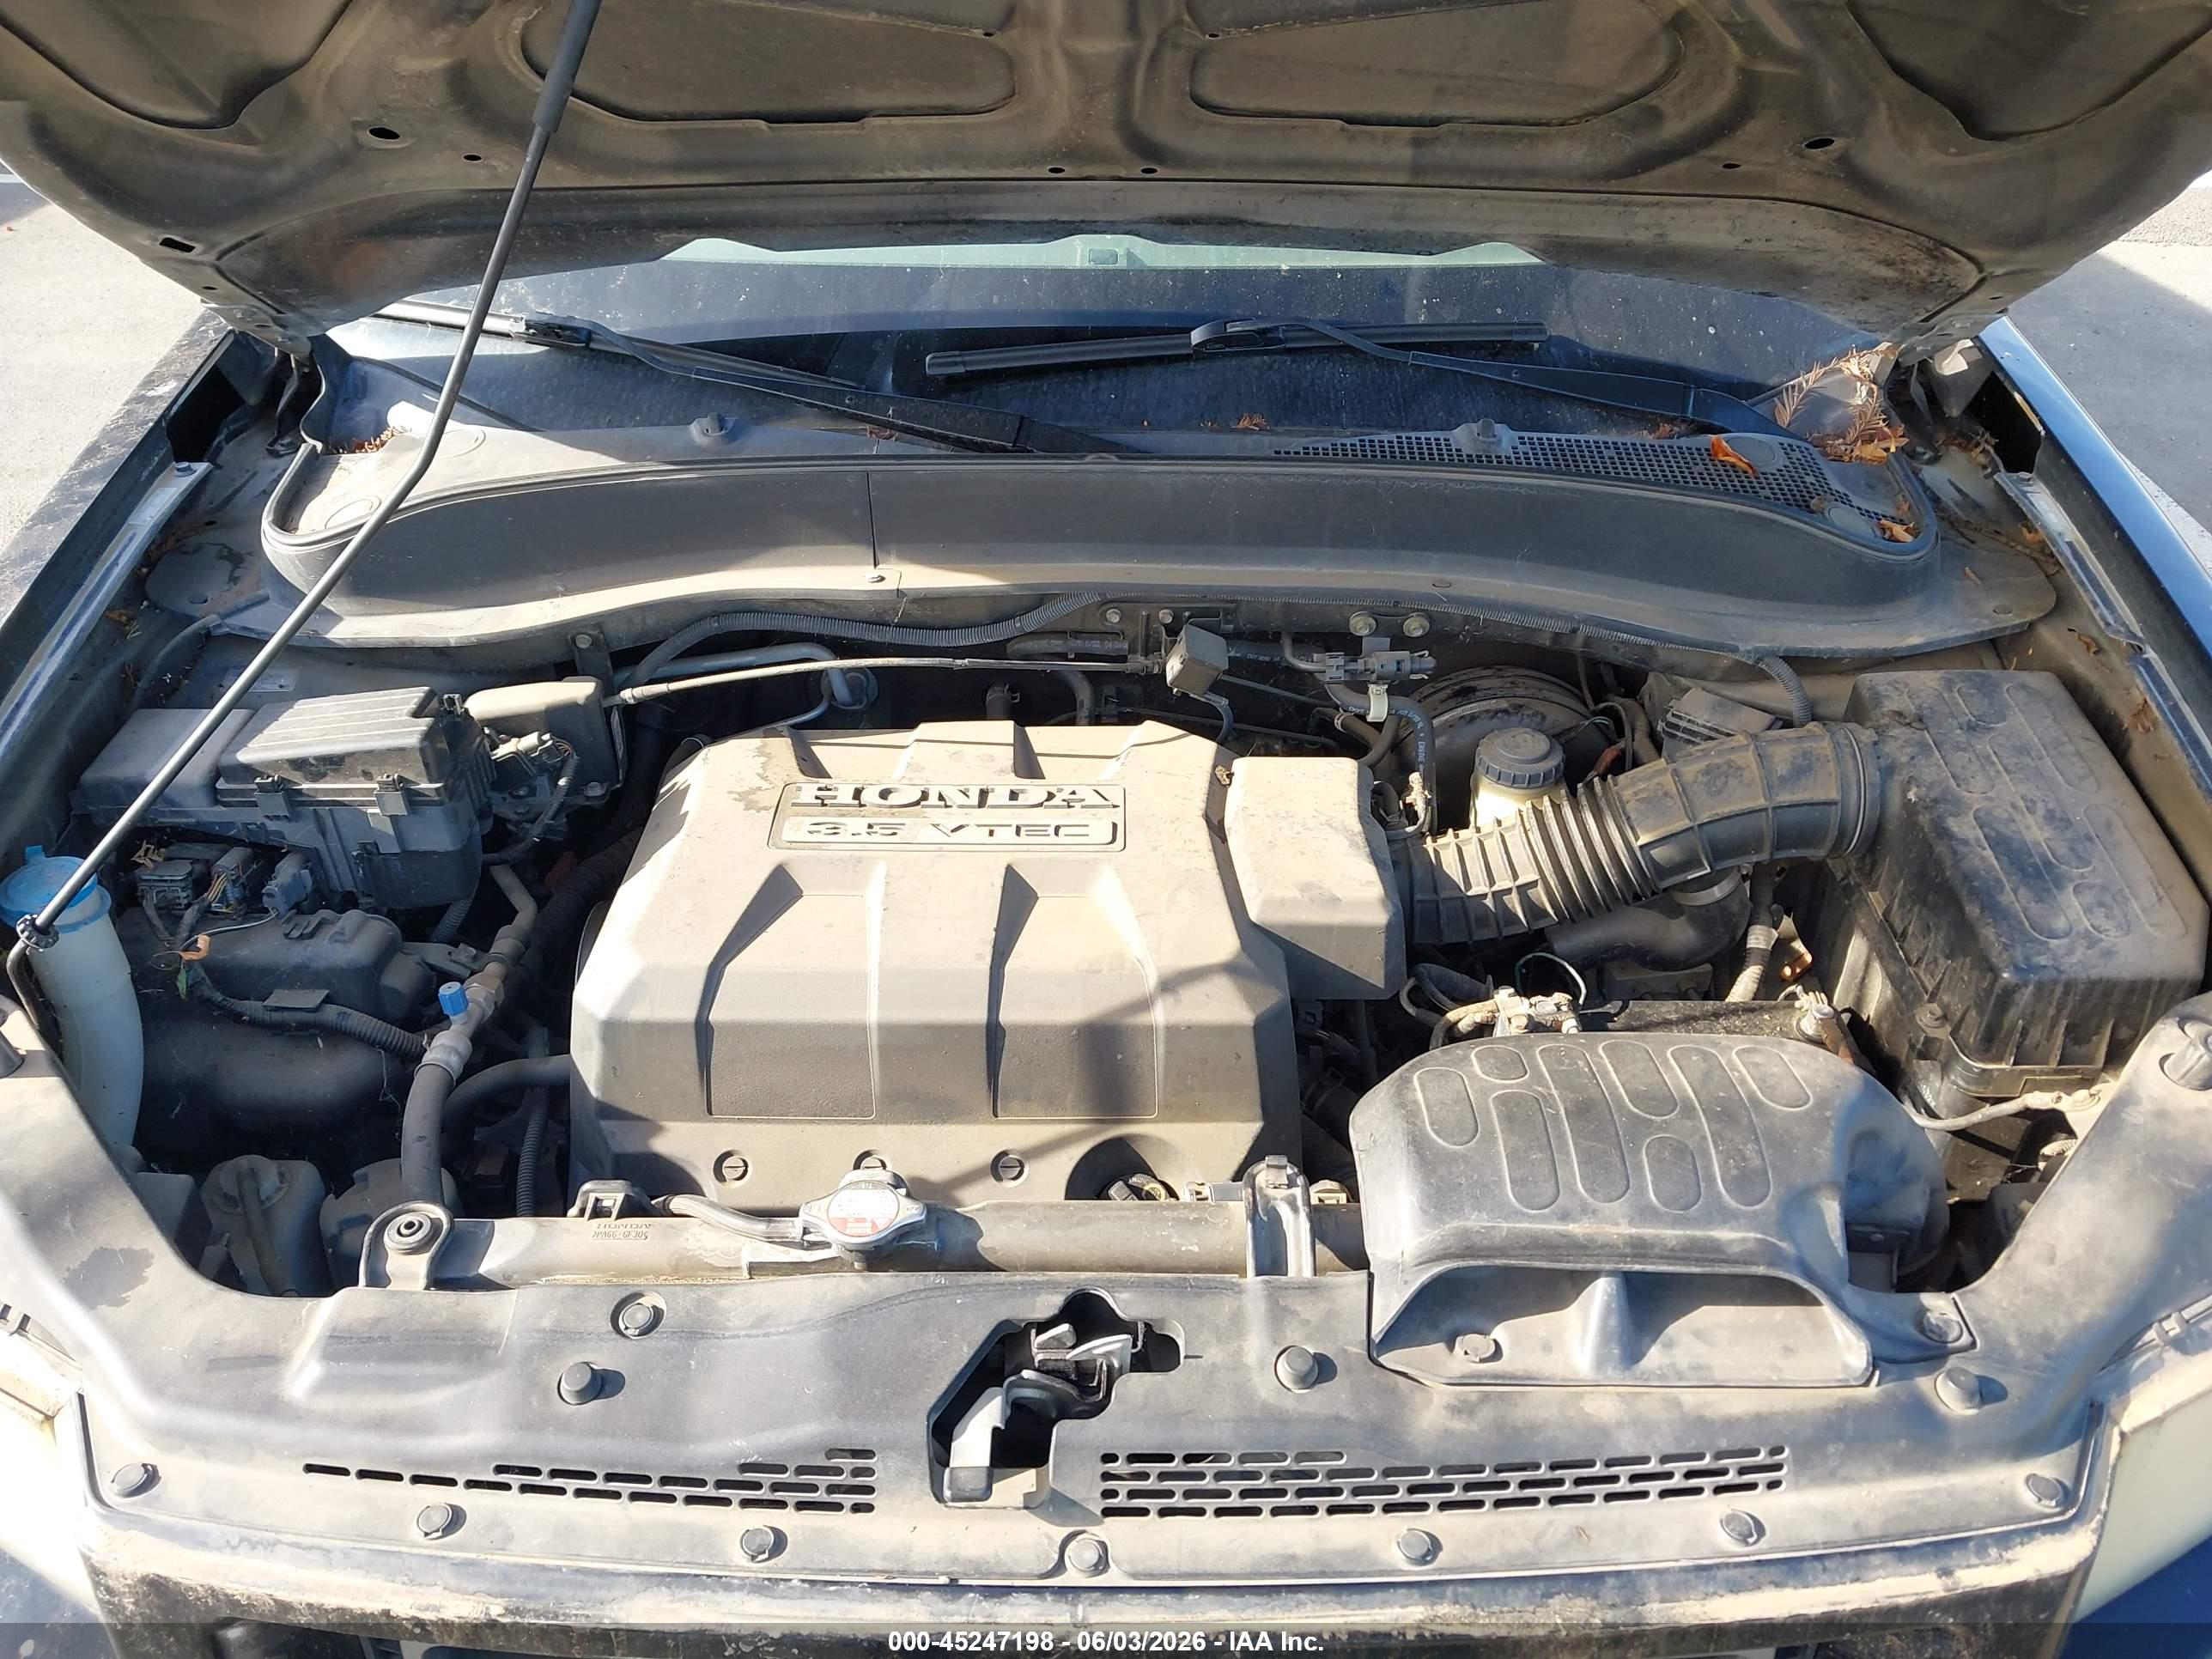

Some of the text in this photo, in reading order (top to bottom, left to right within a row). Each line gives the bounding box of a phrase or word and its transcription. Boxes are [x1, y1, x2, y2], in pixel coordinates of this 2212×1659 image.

[790, 785, 1121, 809] HONDA
[806, 821, 1090, 838] 3.5 VTEC
